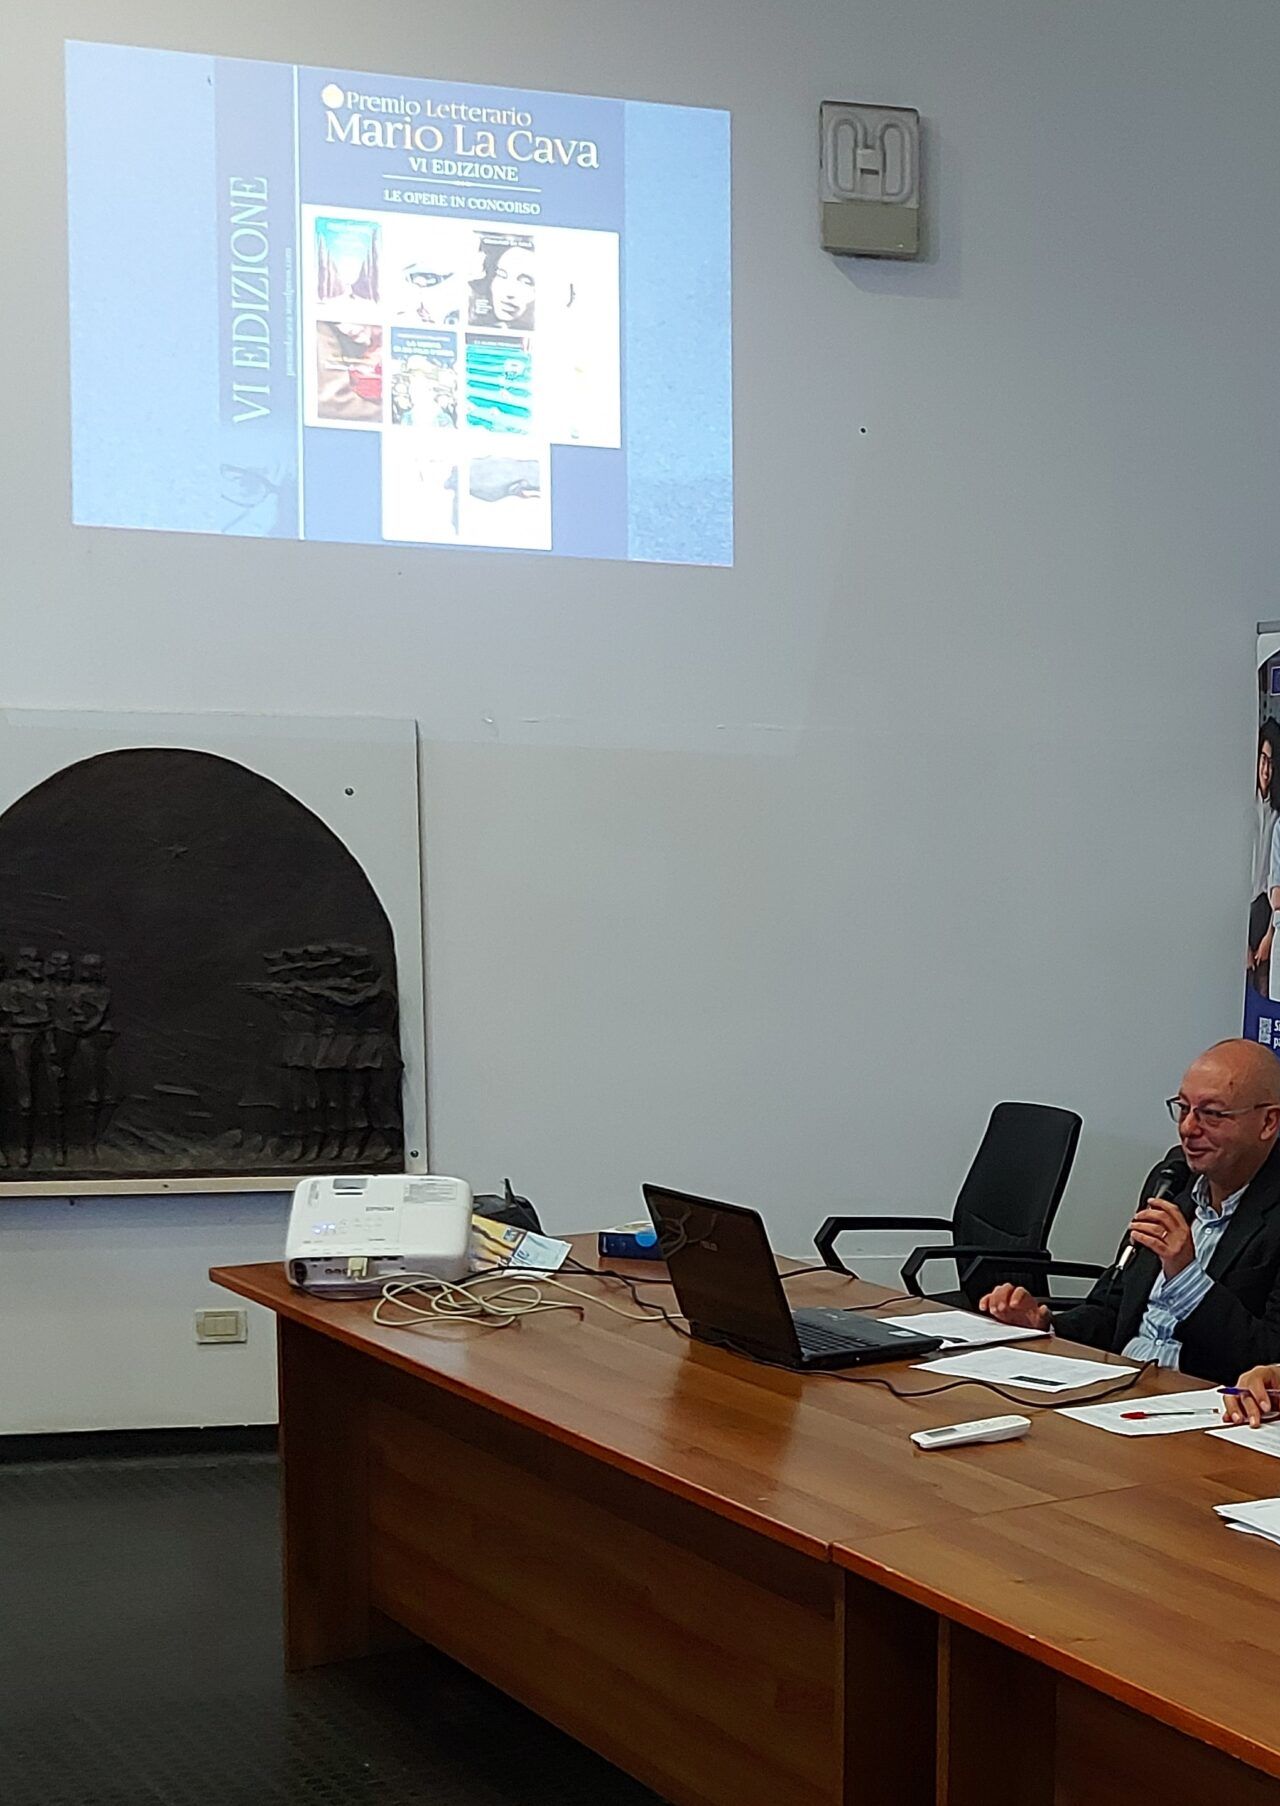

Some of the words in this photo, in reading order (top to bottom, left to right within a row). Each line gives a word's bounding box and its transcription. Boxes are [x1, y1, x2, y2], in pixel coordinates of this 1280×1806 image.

[347, 91, 421, 116] Premio
[427, 99, 532, 128] Letterario
[325, 111, 444, 152] Mario
[454, 124, 497, 159] La
[507, 130, 600, 169] Cava
[409, 157, 428, 173] VI
[432, 159, 519, 182] EDIZIONE
[384, 189, 401, 202] LE
[403, 191, 448, 208] OPERE
[450, 195, 465, 209] IN
[468, 198, 541, 215] CONCORSO
[229, 177, 270, 370] EDIZIONE
[233, 382, 271, 424] VI
